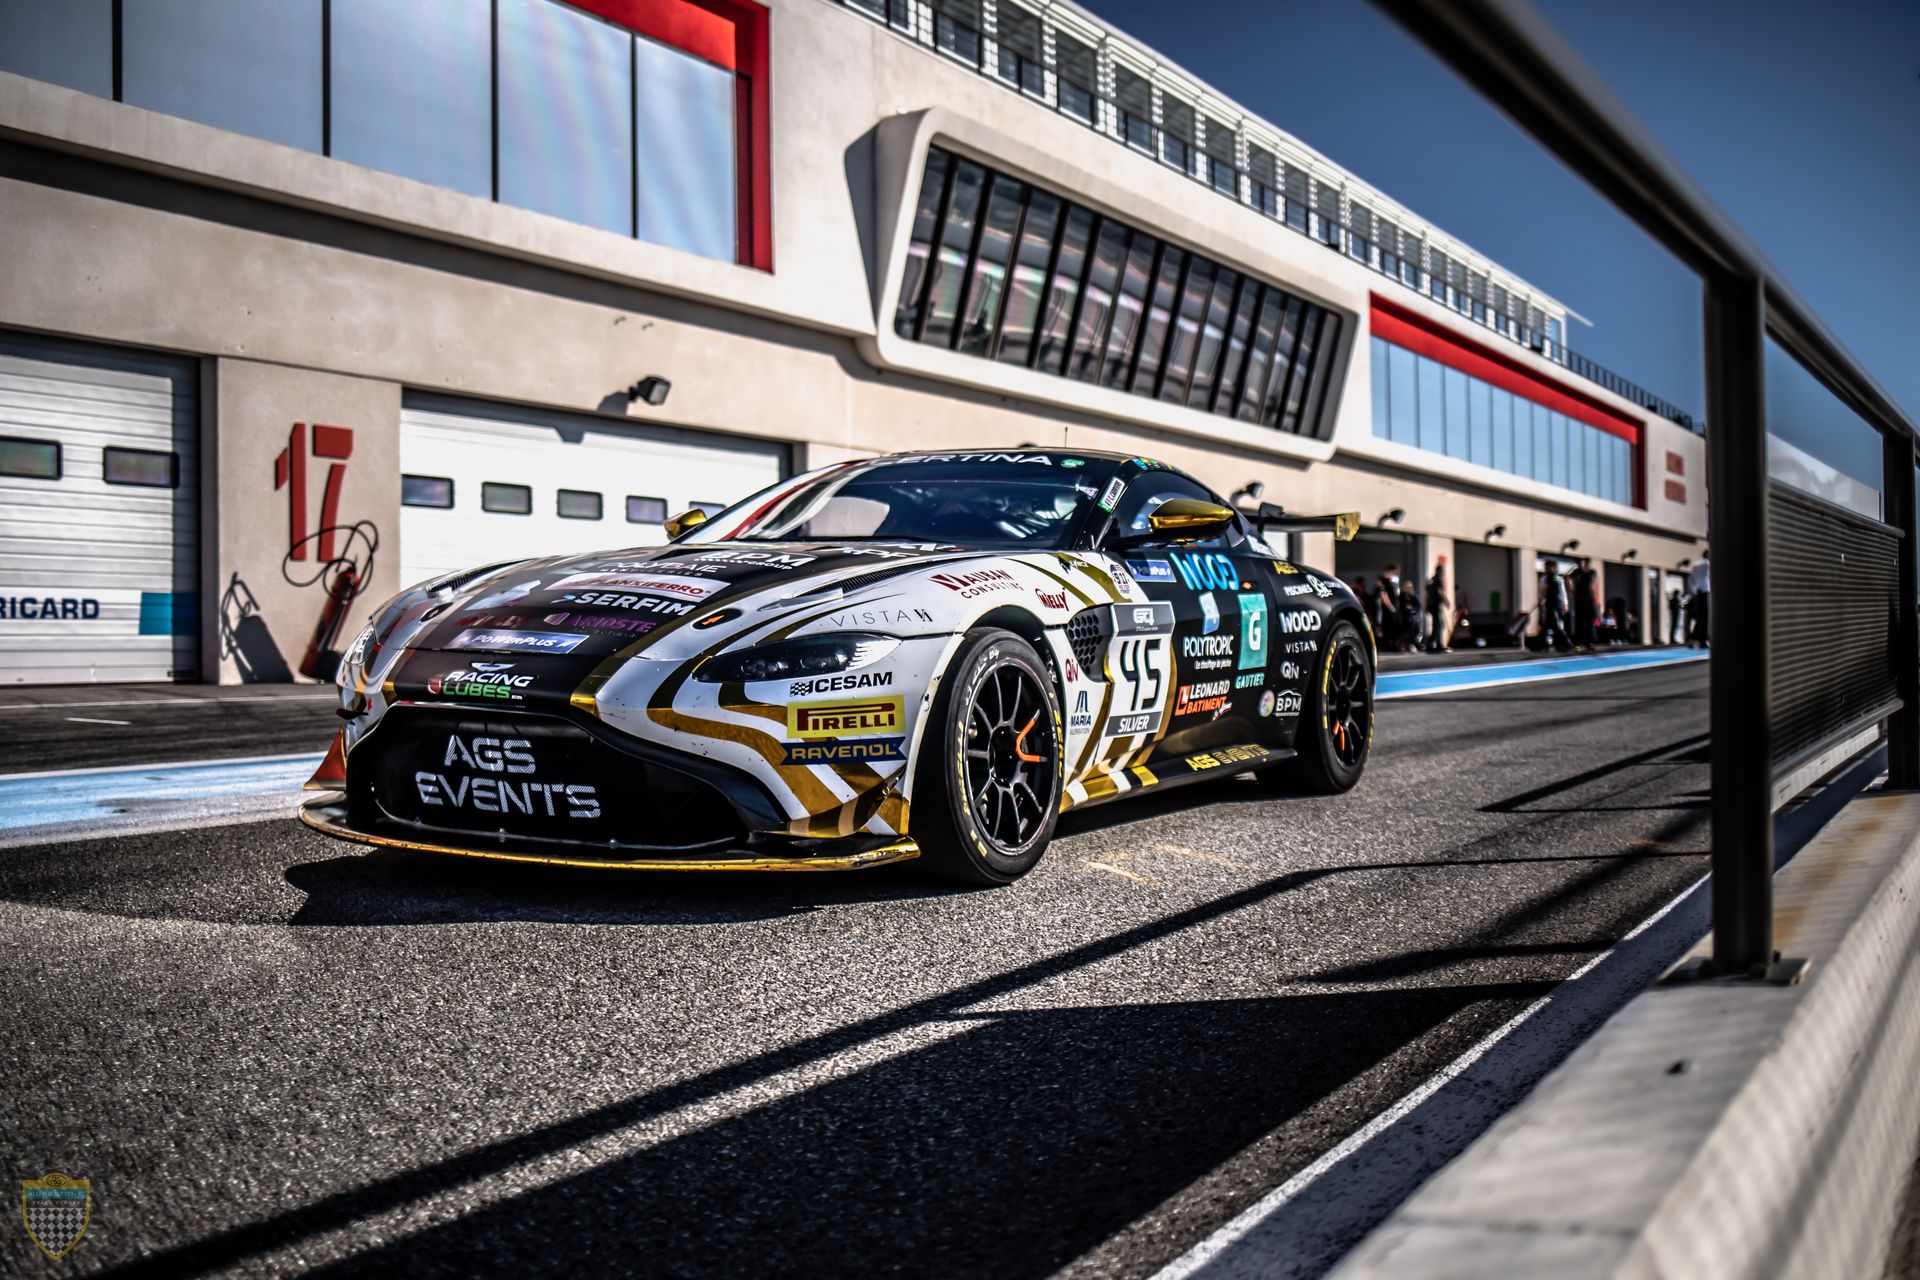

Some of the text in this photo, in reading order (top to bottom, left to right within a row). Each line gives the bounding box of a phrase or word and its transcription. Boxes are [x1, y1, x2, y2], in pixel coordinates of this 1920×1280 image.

[275, 422, 353, 563] 17
[1169, 552, 1239, 591] WOOD
[961, 582, 1024, 599] CONSULTING
[574, 592, 697, 616] SERFIM
[1249, 611, 1261, 651] G
[1279, 610, 1321, 633] WOOD
[1183, 635, 1234, 657] POLYTROPIC
[444, 671, 534, 688] RACING
[814, 671, 893, 693] CESAM
[1120, 639, 1162, 712] 45
[1235, 673, 1265, 690] GAUTIER
[442, 682, 512, 699] LUBES
[1189, 680, 1231, 700] LEONARD
[1186, 696, 1228, 715] BATIMENT
[1276, 697, 1302, 712] BPM
[797, 702, 896, 732] PIRELLI
[1070, 714, 1092, 727] MARIA
[1117, 715, 1150, 733] SILVER
[443, 734, 537, 774] AGS
[791, 743, 897, 760] RAVENOL
[1186, 754, 1221, 772] AGS
[414, 771, 602, 818] EVENTS
